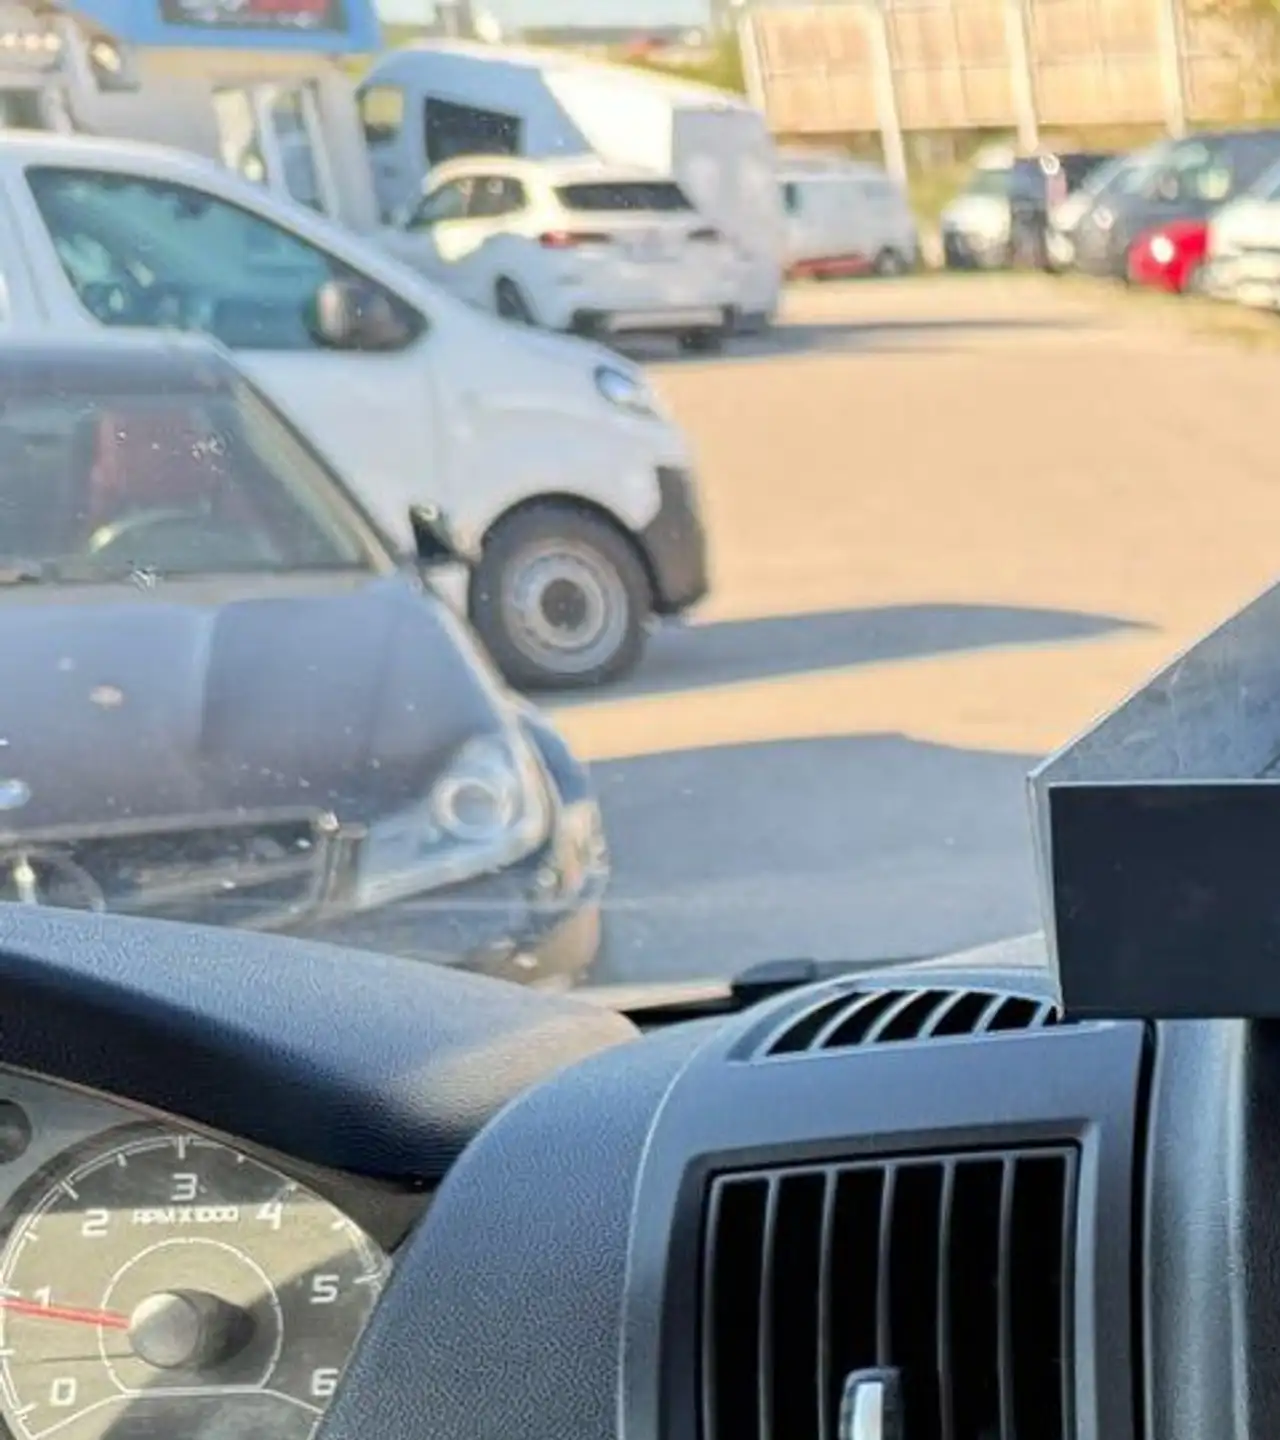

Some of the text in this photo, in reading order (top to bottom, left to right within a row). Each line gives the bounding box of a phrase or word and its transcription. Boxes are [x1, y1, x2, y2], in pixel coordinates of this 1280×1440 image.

[172, 1174, 198, 1201] 3
[81, 1209, 109, 1237] 2
[256, 1203, 284, 1230] 4
[33, 1285, 52, 1307] 1
[310, 1275, 339, 1303] 5
[51, 1378, 77, 1406] 0
[312, 1368, 339, 1395] 6
